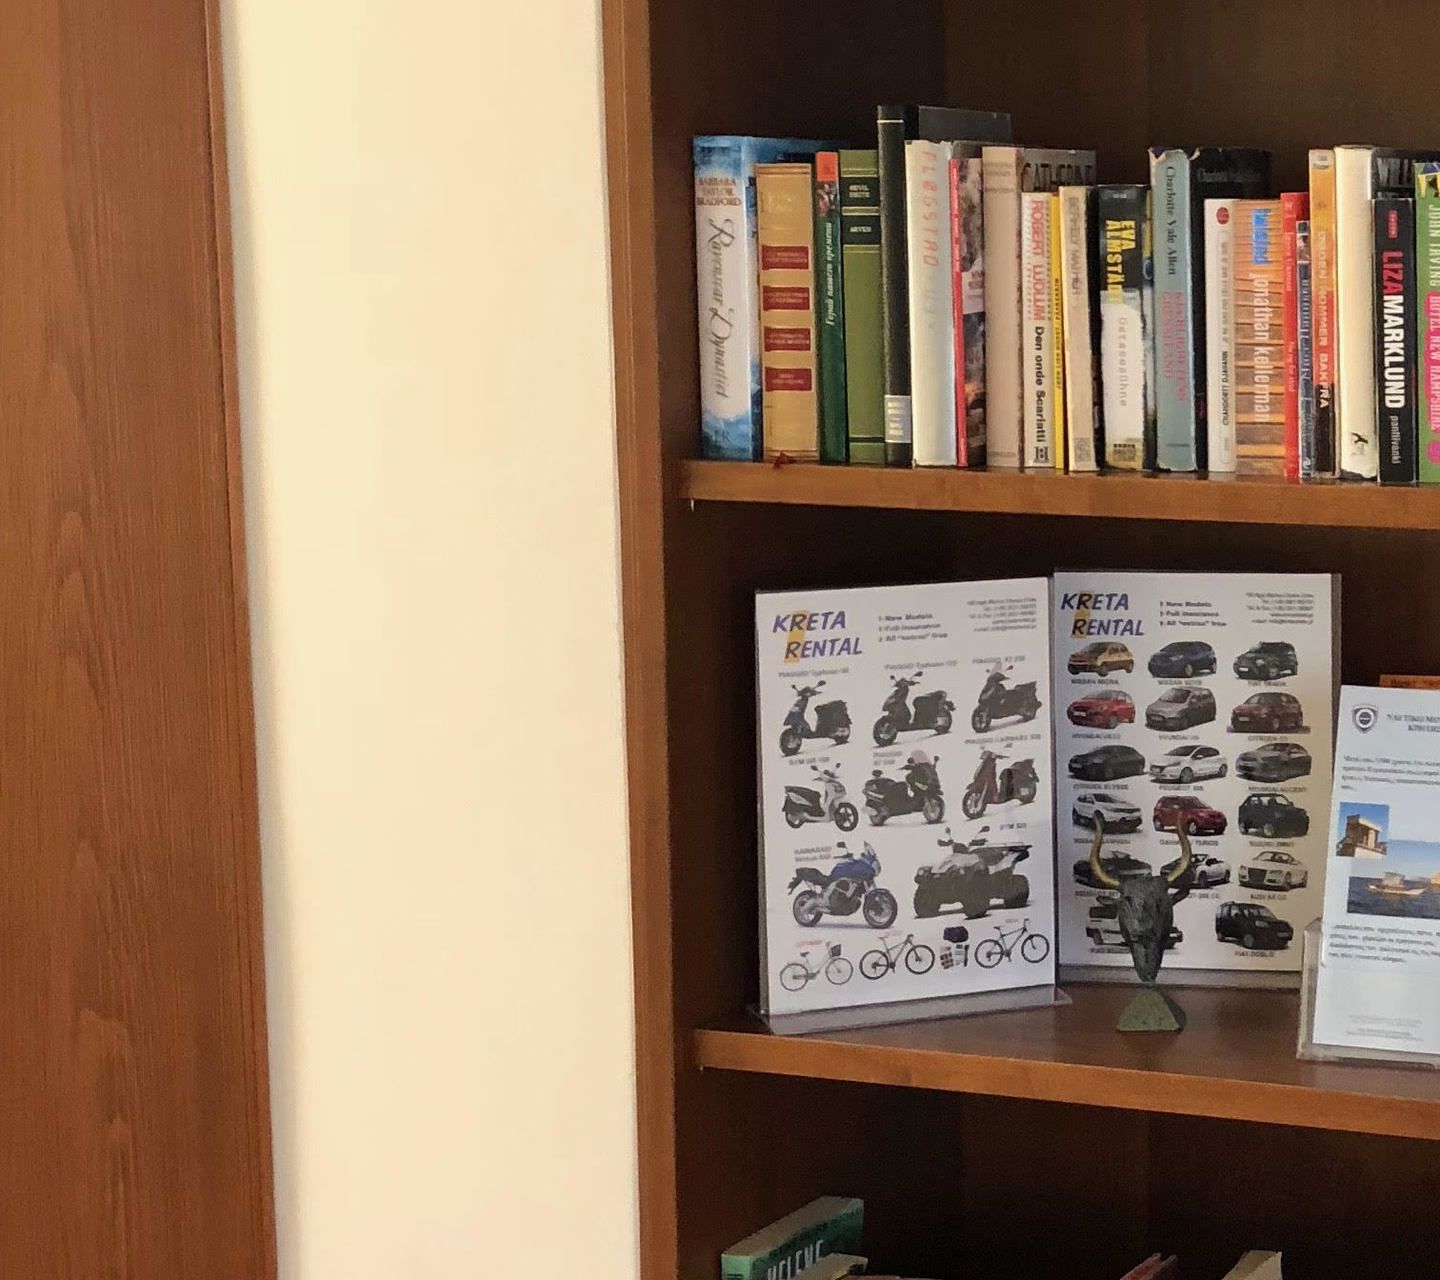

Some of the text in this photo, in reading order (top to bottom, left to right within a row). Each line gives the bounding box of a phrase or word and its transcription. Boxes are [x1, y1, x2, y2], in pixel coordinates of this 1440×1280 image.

[1120, 220, 1136, 249] EVA
[1165, 166, 1179, 275] Charlotte Vale Allen
[1031, 200, 1046, 321] ROBERT LUDLUM
[1249, 273, 1275, 423] jonathan kellerman
[1382, 251, 1404, 408] LIZA MARKLUND
[1034, 326, 1047, 443] Den onde Scarlatti
[773, 611, 846, 633] KRETA
[1061, 593, 1129, 611] KRETA
[1072, 618, 1145, 636] RENTAL
[785, 637, 863, 660] RENTAL
